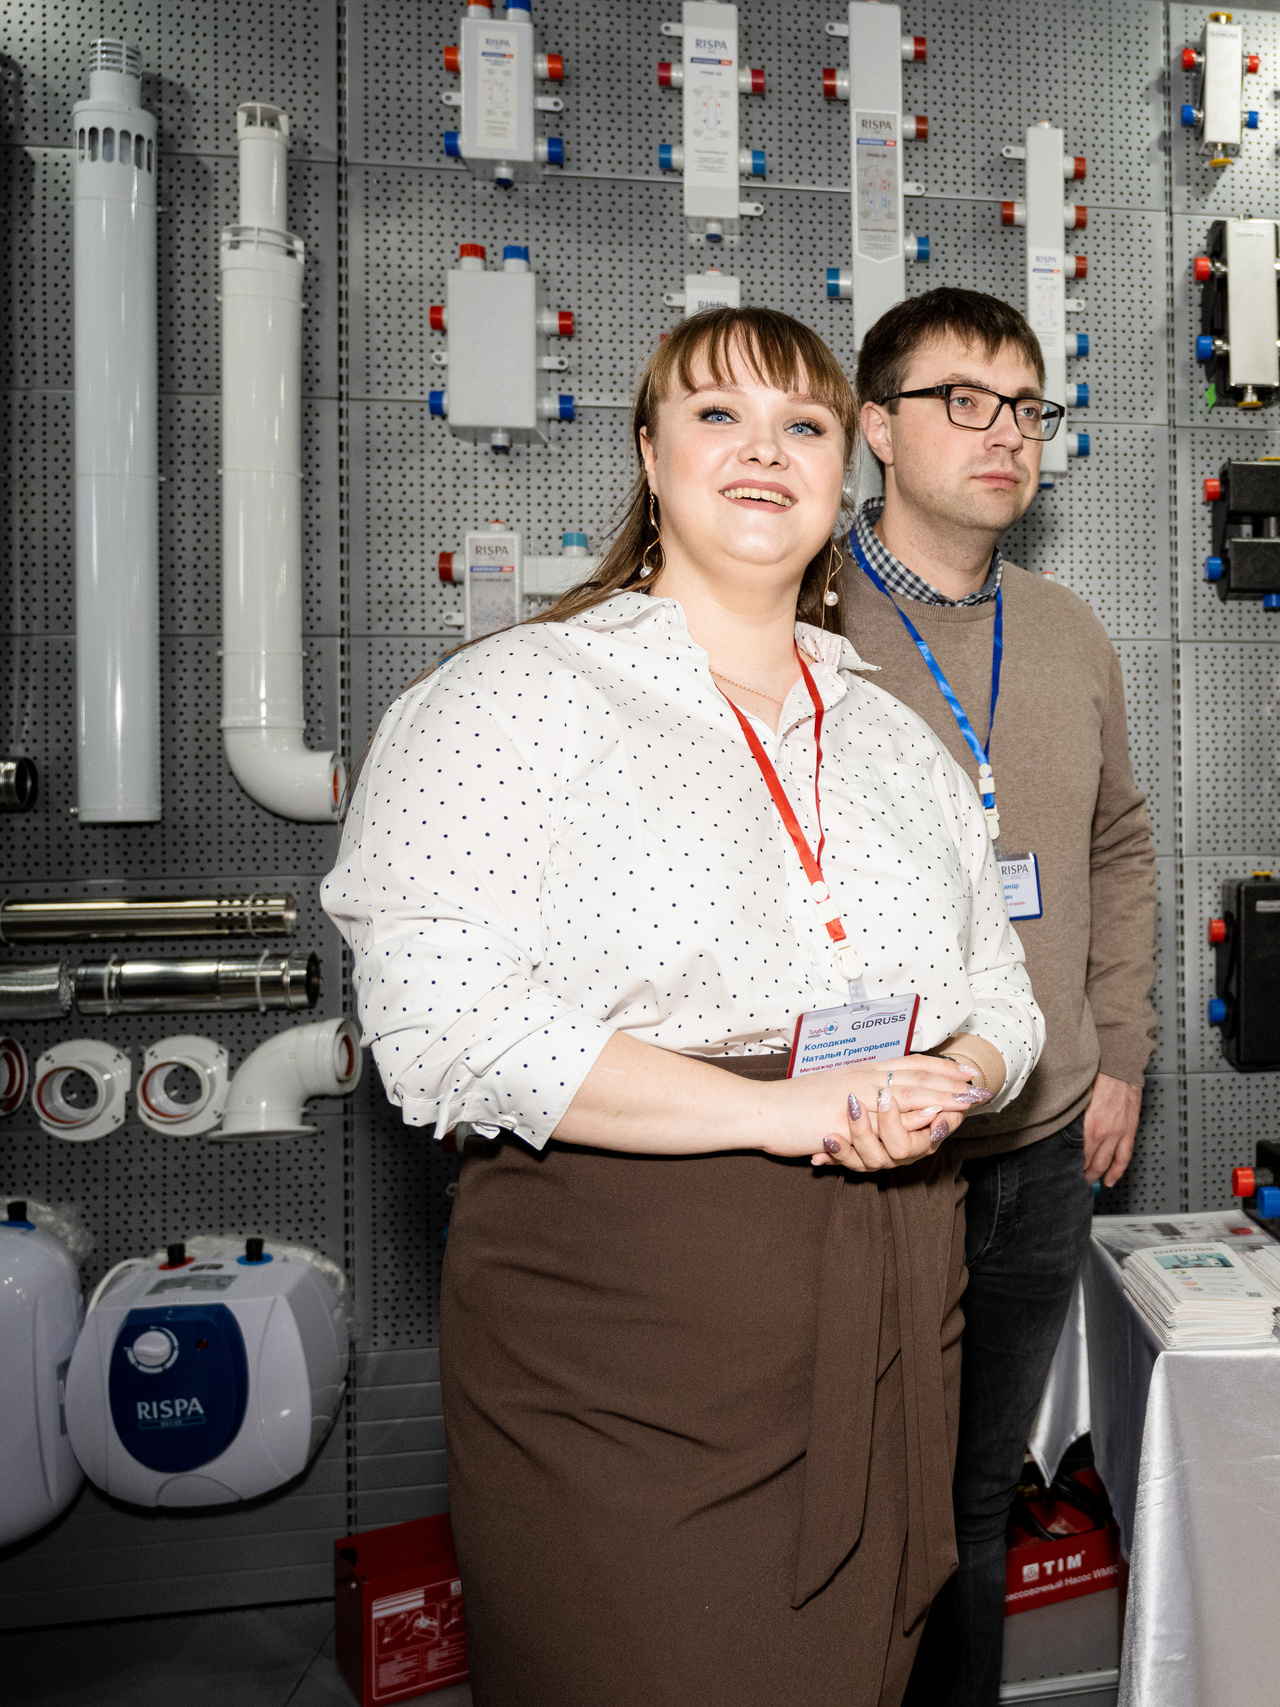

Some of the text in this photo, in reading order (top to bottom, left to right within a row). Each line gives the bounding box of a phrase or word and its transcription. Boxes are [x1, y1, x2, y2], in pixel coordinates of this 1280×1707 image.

[696, 38, 728, 51] RISPA
[861, 119, 892, 130] RISPA
[475, 545, 509, 556] RISPA
[1001, 864, 1029, 875] RISPA
[851, 1013, 906, 1031] GIDRUSS
[804, 1036, 856, 1051] Колодкина
[802, 1039, 901, 1064] Наталья Григорьевна
[843, 1055, 877, 1066] продажам
[1153, 1246, 1215, 1255] GIDRUSS
[136, 1396, 205, 1420] RISPA
[1042, 1553, 1082, 1576] TIM
[1064, 1572, 1092, 1586] Насос
